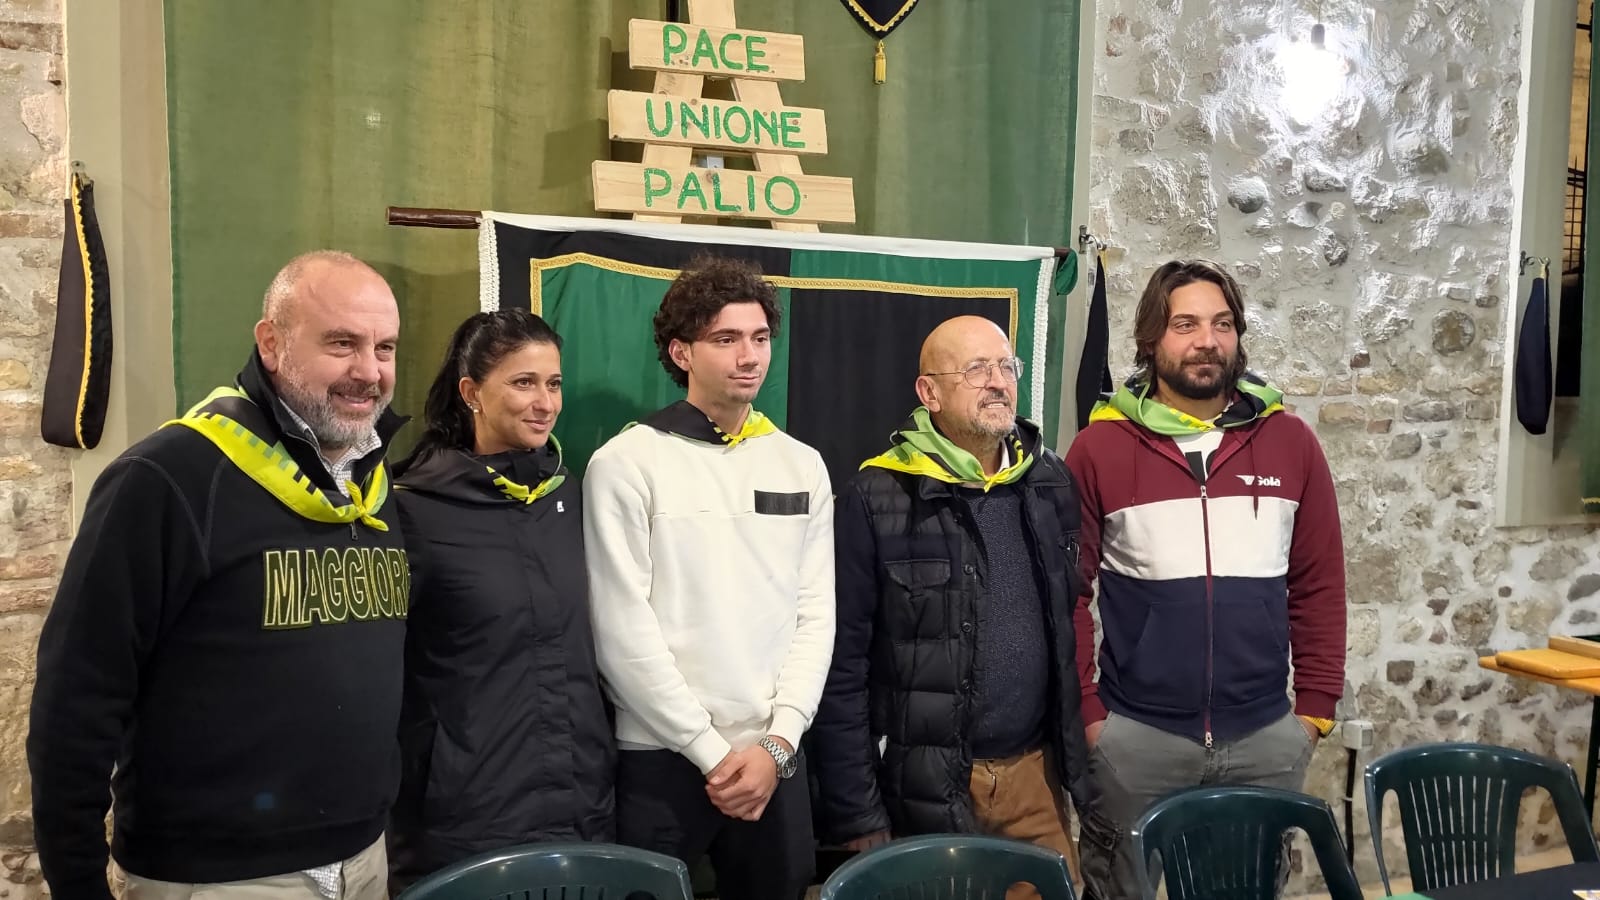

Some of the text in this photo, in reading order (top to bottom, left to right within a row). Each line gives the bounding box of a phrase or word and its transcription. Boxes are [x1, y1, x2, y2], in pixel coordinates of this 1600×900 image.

[663, 24, 769, 71] PACE
[646, 99, 806, 149] UNIONE
[644, 168, 801, 216] PALIO
